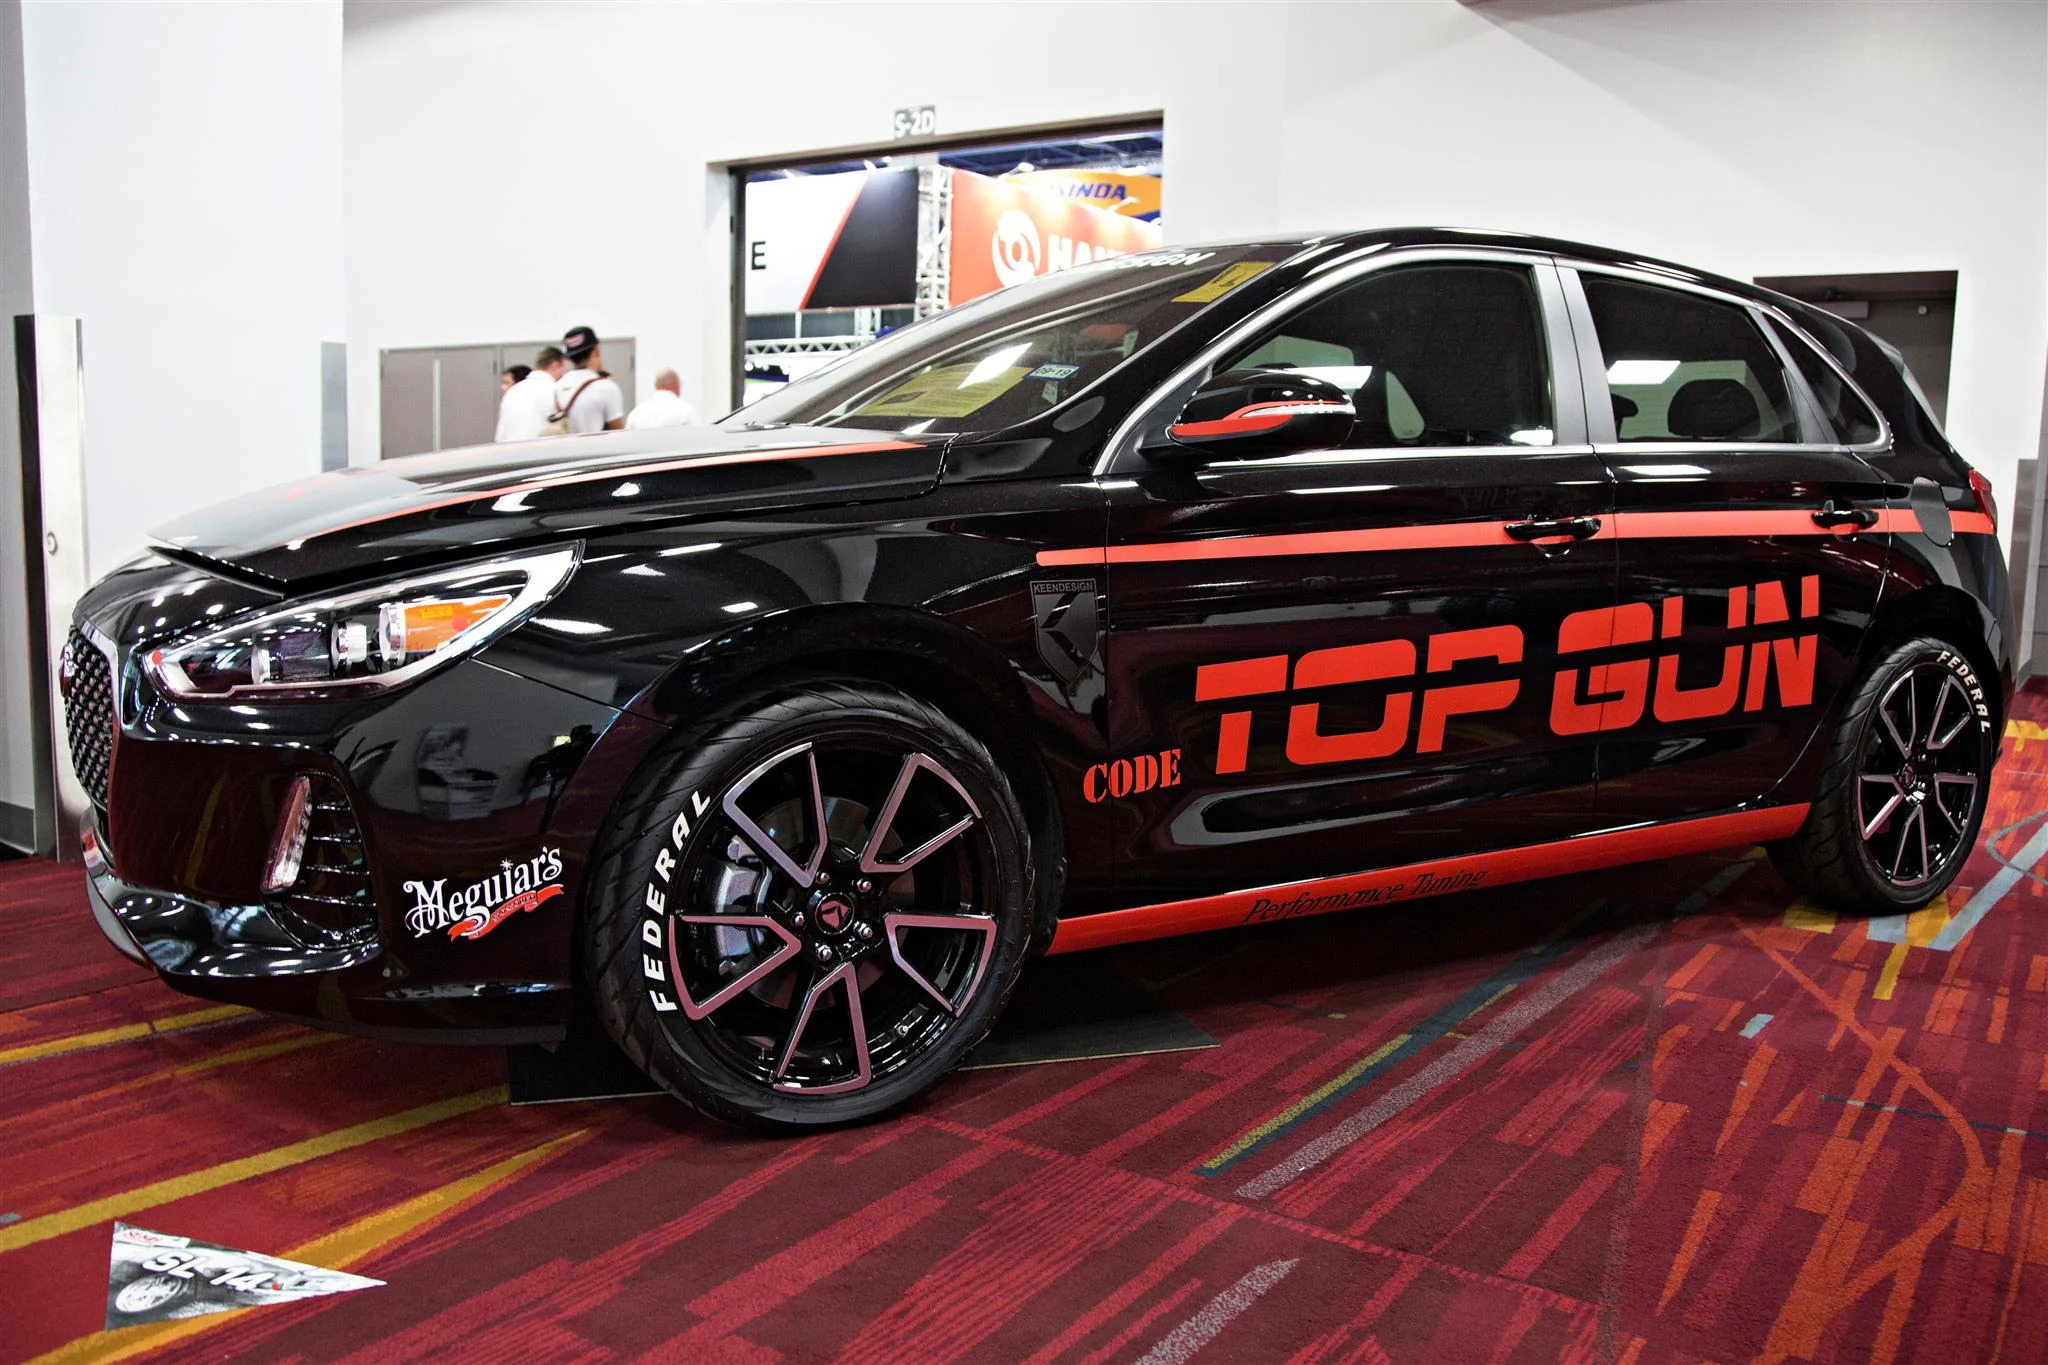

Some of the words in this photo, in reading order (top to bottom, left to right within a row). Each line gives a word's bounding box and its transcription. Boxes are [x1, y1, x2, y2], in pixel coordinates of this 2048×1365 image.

[895, 110, 935, 138] S-2D
[752, 241, 766, 270] E
[1033, 581, 1093, 593] KEENDESIGN
[1195, 625, 1524, 774] TOP
[1550, 575, 1819, 736] GUN
[1936, 650, 1991, 733] FEDERAL
[1083, 749, 1181, 803] CODE
[403, 846, 564, 938] Meguiar's
[643, 791, 710, 1012] FEDERAL
[1241, 881, 1404, 924] Performance
[1410, 868, 1489, 897] Tuning
